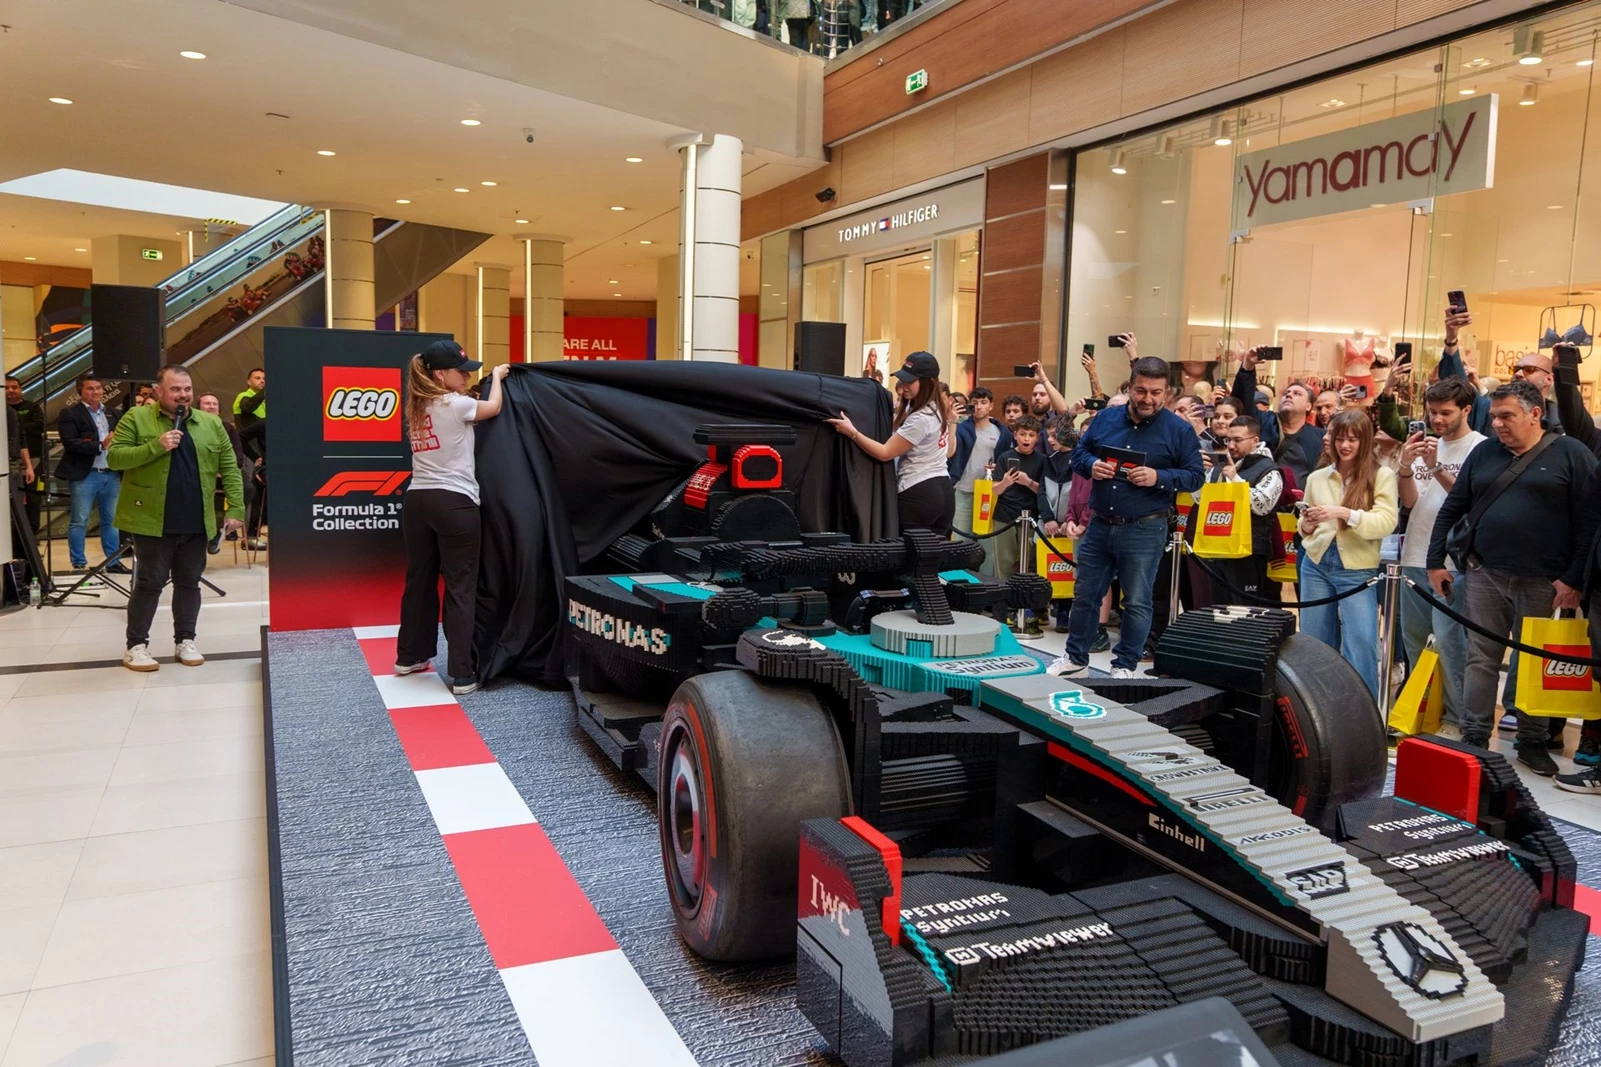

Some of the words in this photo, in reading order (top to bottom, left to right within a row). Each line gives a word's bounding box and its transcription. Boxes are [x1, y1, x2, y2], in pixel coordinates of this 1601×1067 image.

[1244, 112, 1476, 217] yamamay
[838, 221, 877, 242] TOMMY
[891, 204, 938, 229] HILFIGER
[563, 338, 589, 350] ARE
[591, 339, 617, 350] ALL
[327, 388, 398, 419] LEGO
[312, 503, 384, 516] Formula
[312, 516, 399, 530] Collection
[1207, 512, 1232, 525] LEGO
[568, 598, 668, 655] PETRONAS
[945, 661, 1034, 674] Syntium
[1546, 659, 1588, 676] LEGO
[1148, 812, 1205, 852] Einhell
[810, 873, 850, 937] IWC
[900, 891, 1009, 921] PETRONAS
[915, 908, 1011, 934] Syntium
